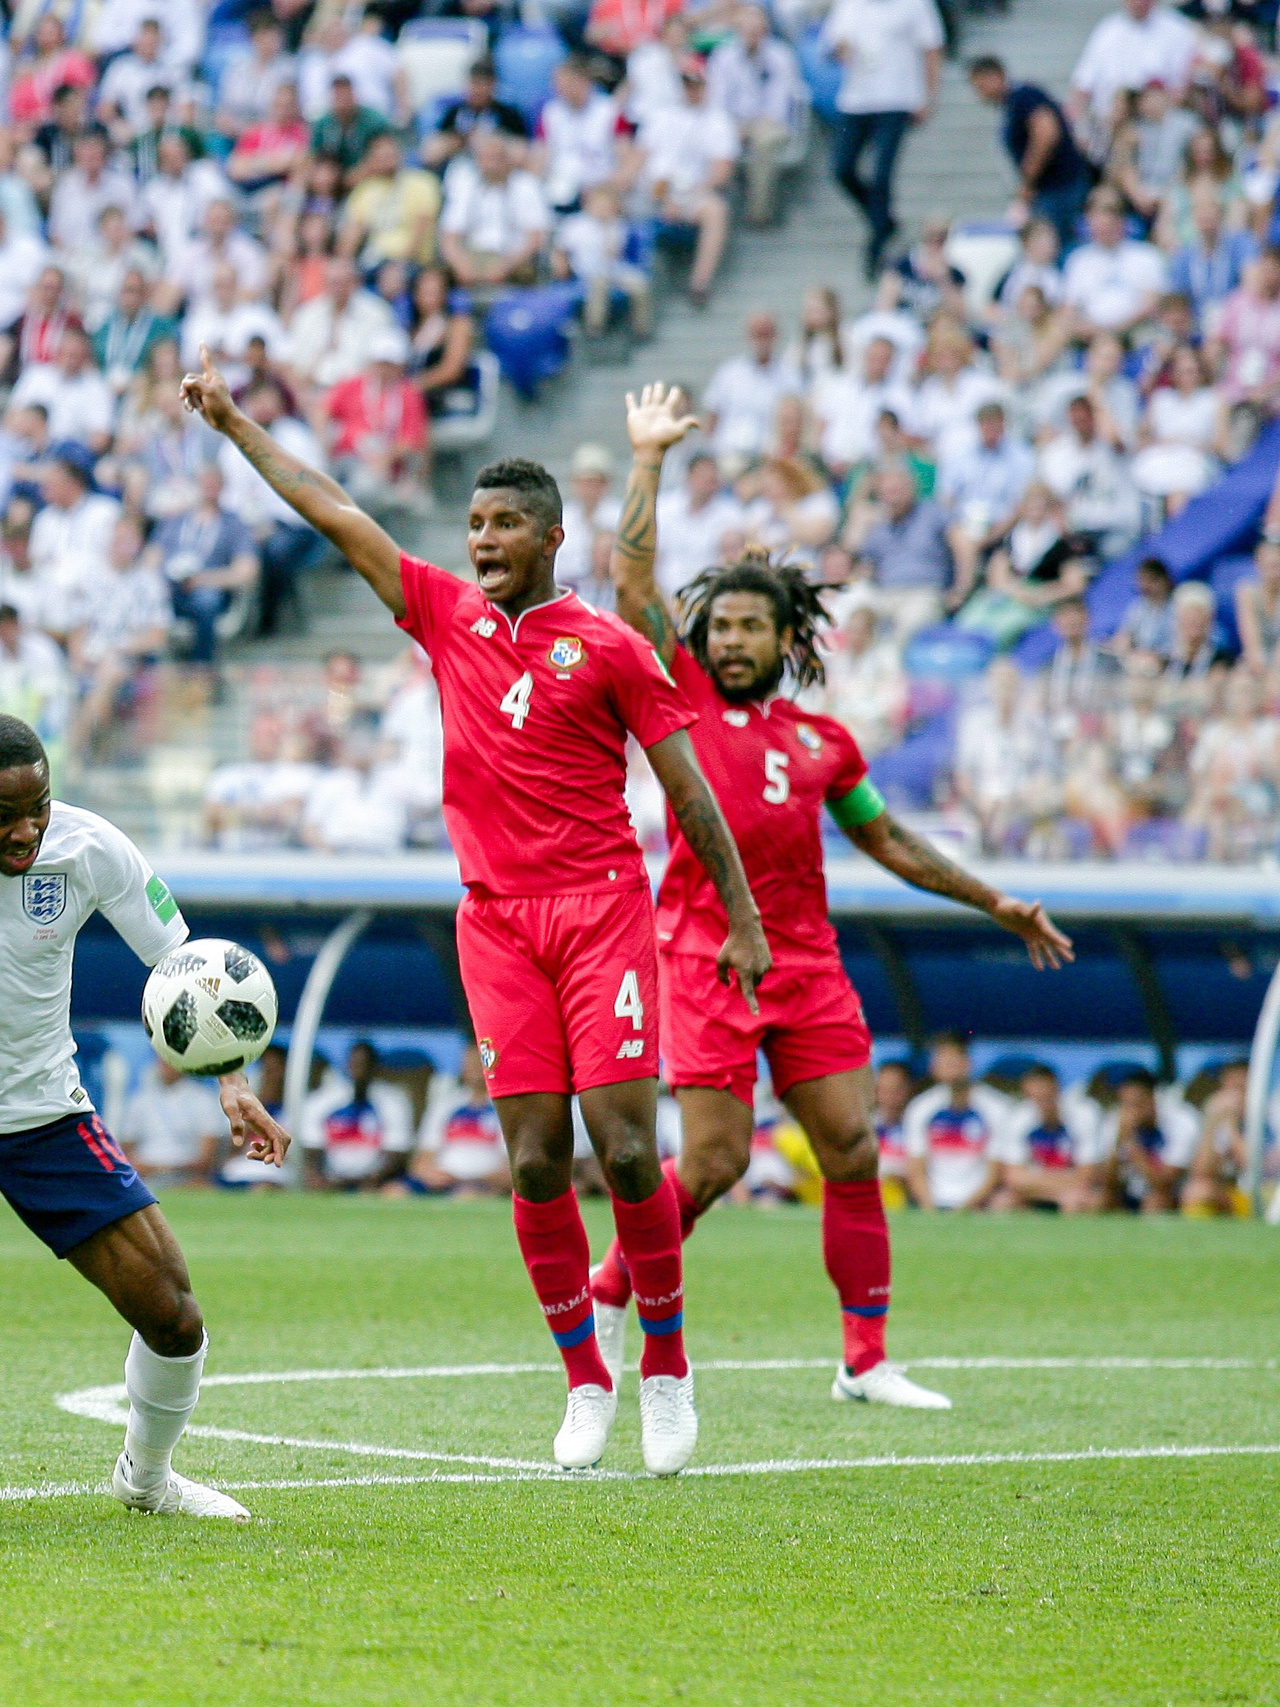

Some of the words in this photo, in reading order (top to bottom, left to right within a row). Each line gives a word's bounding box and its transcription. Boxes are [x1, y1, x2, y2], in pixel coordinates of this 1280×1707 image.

[499, 670, 534, 730] 4
[762, 749, 790, 805] 5
[613, 969, 644, 1031] 4
[76, 1112, 129, 1173] 10
